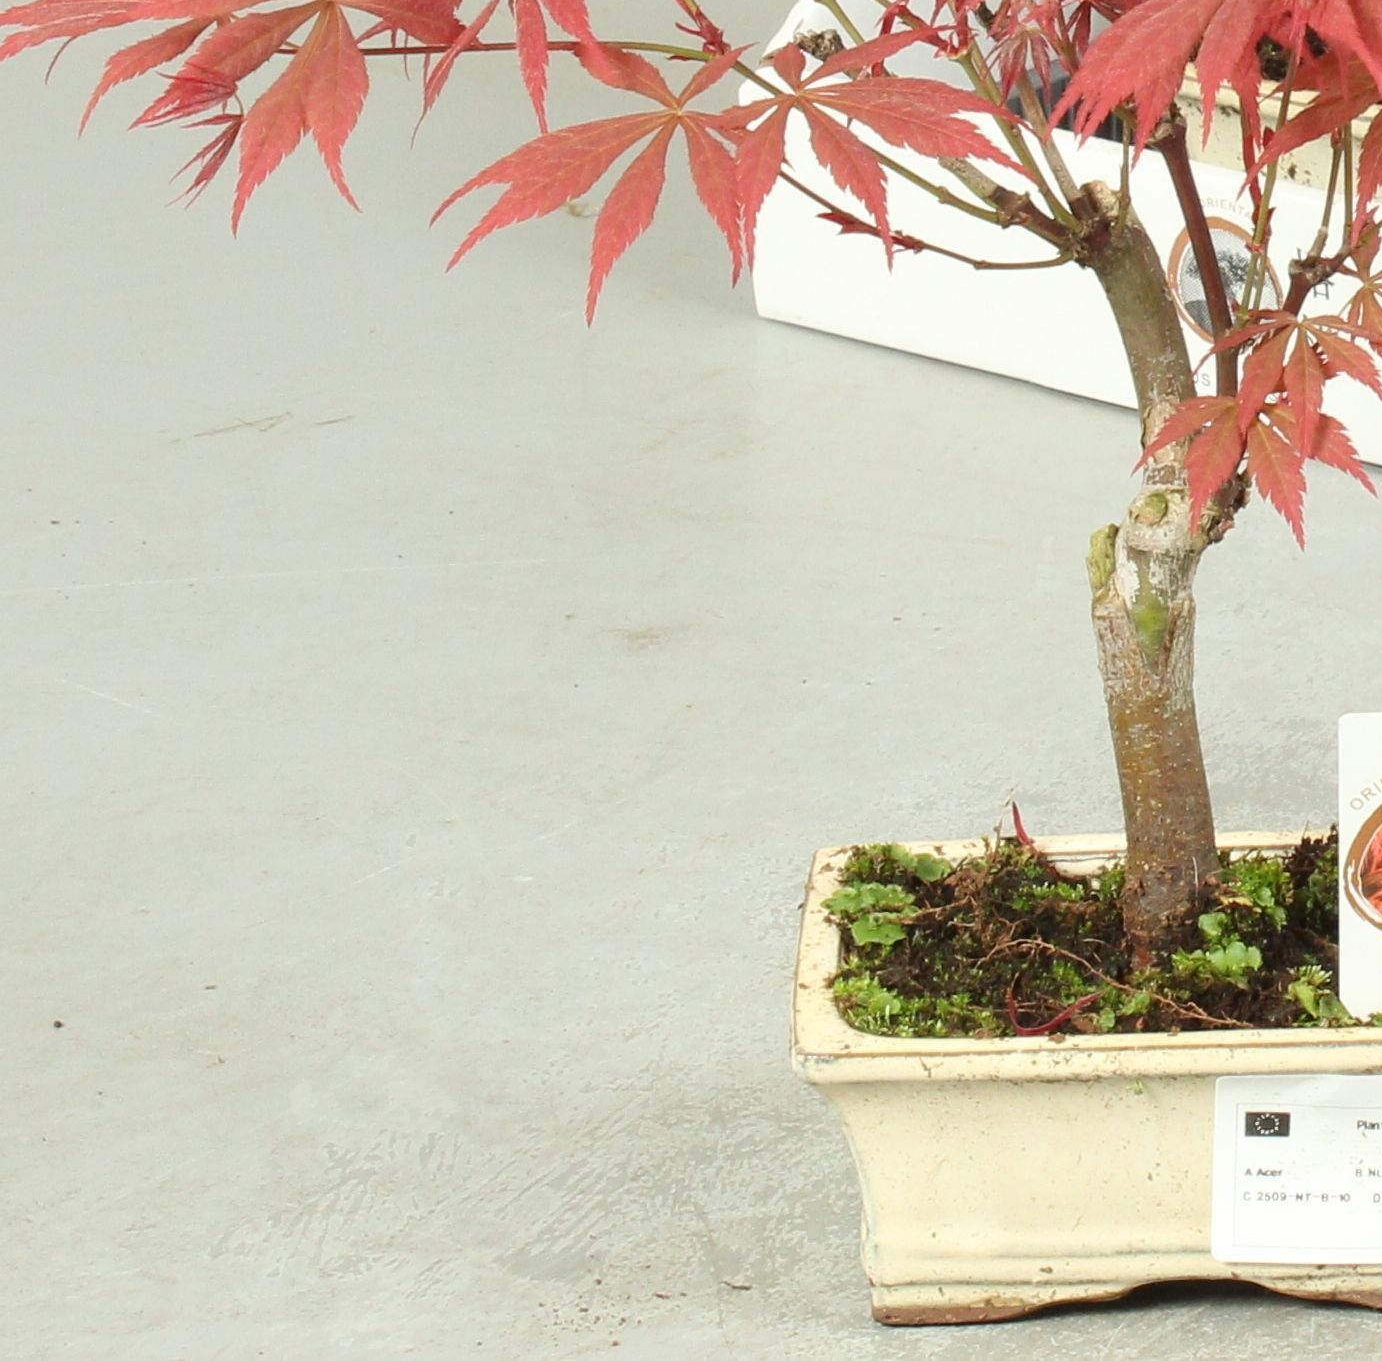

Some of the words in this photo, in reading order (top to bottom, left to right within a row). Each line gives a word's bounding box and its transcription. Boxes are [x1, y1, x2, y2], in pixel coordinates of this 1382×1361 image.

[1245, 1168, 1252, 1177] A
[1257, 1168, 1283, 1177] Acer
[1243, 1192, 1251, 1201] C
[1373, 1193, 1381, 1203] D
